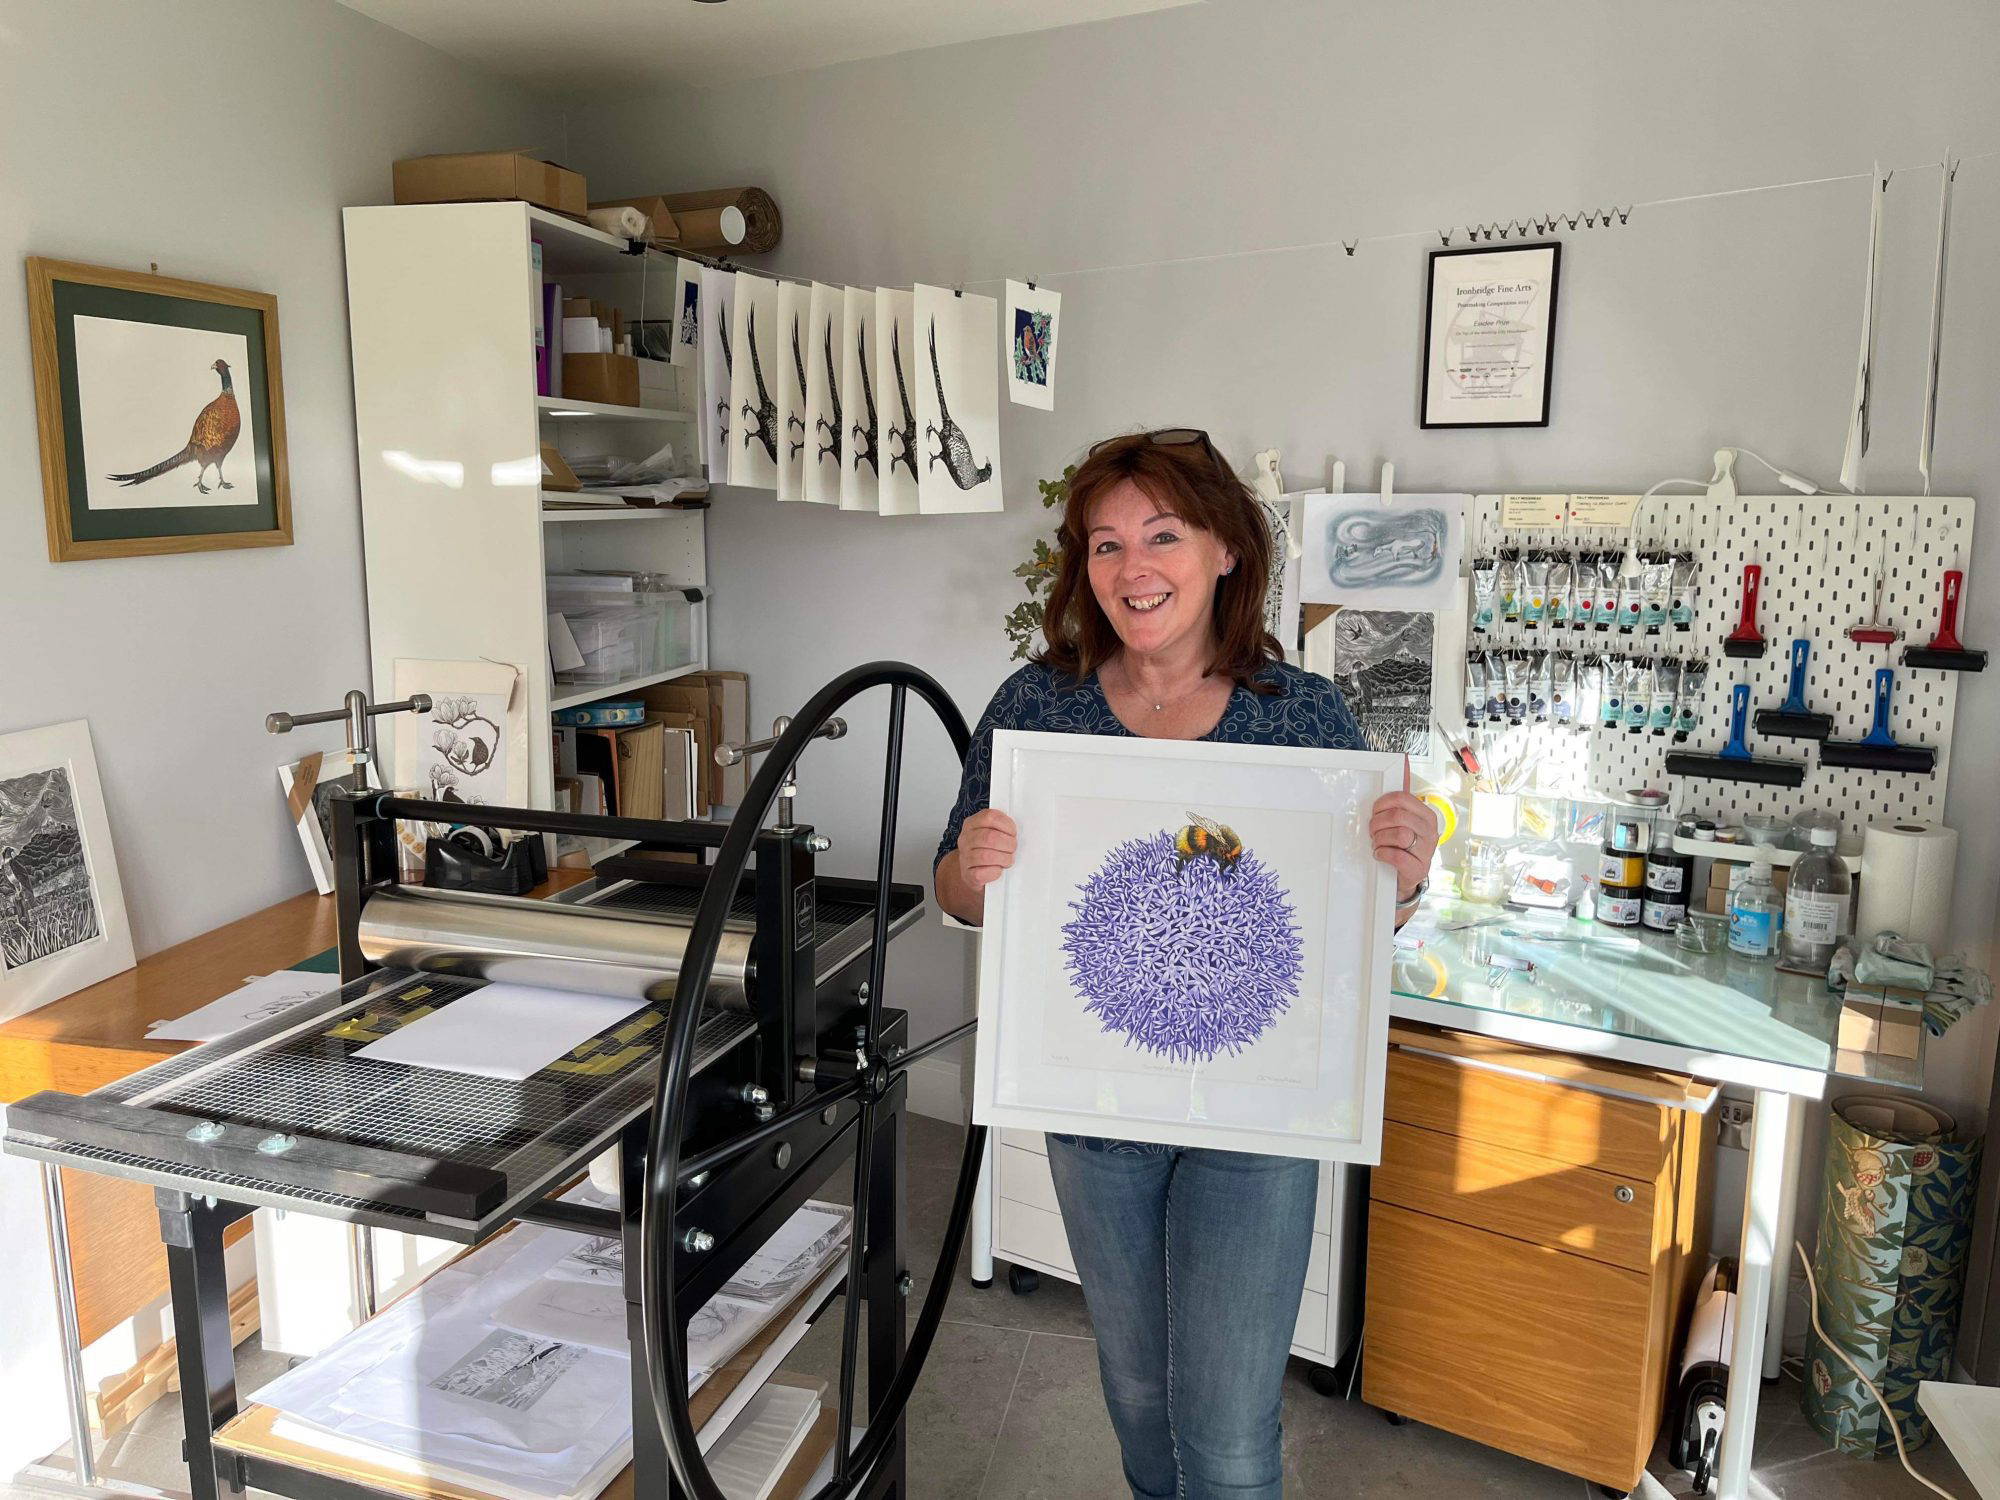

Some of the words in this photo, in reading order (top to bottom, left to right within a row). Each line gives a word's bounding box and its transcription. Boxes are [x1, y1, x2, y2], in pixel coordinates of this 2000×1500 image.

[1457, 286, 1495, 296] Ironbridge
[1497, 285, 1514, 293] Fine
[1515, 284, 1532, 292] Arts
